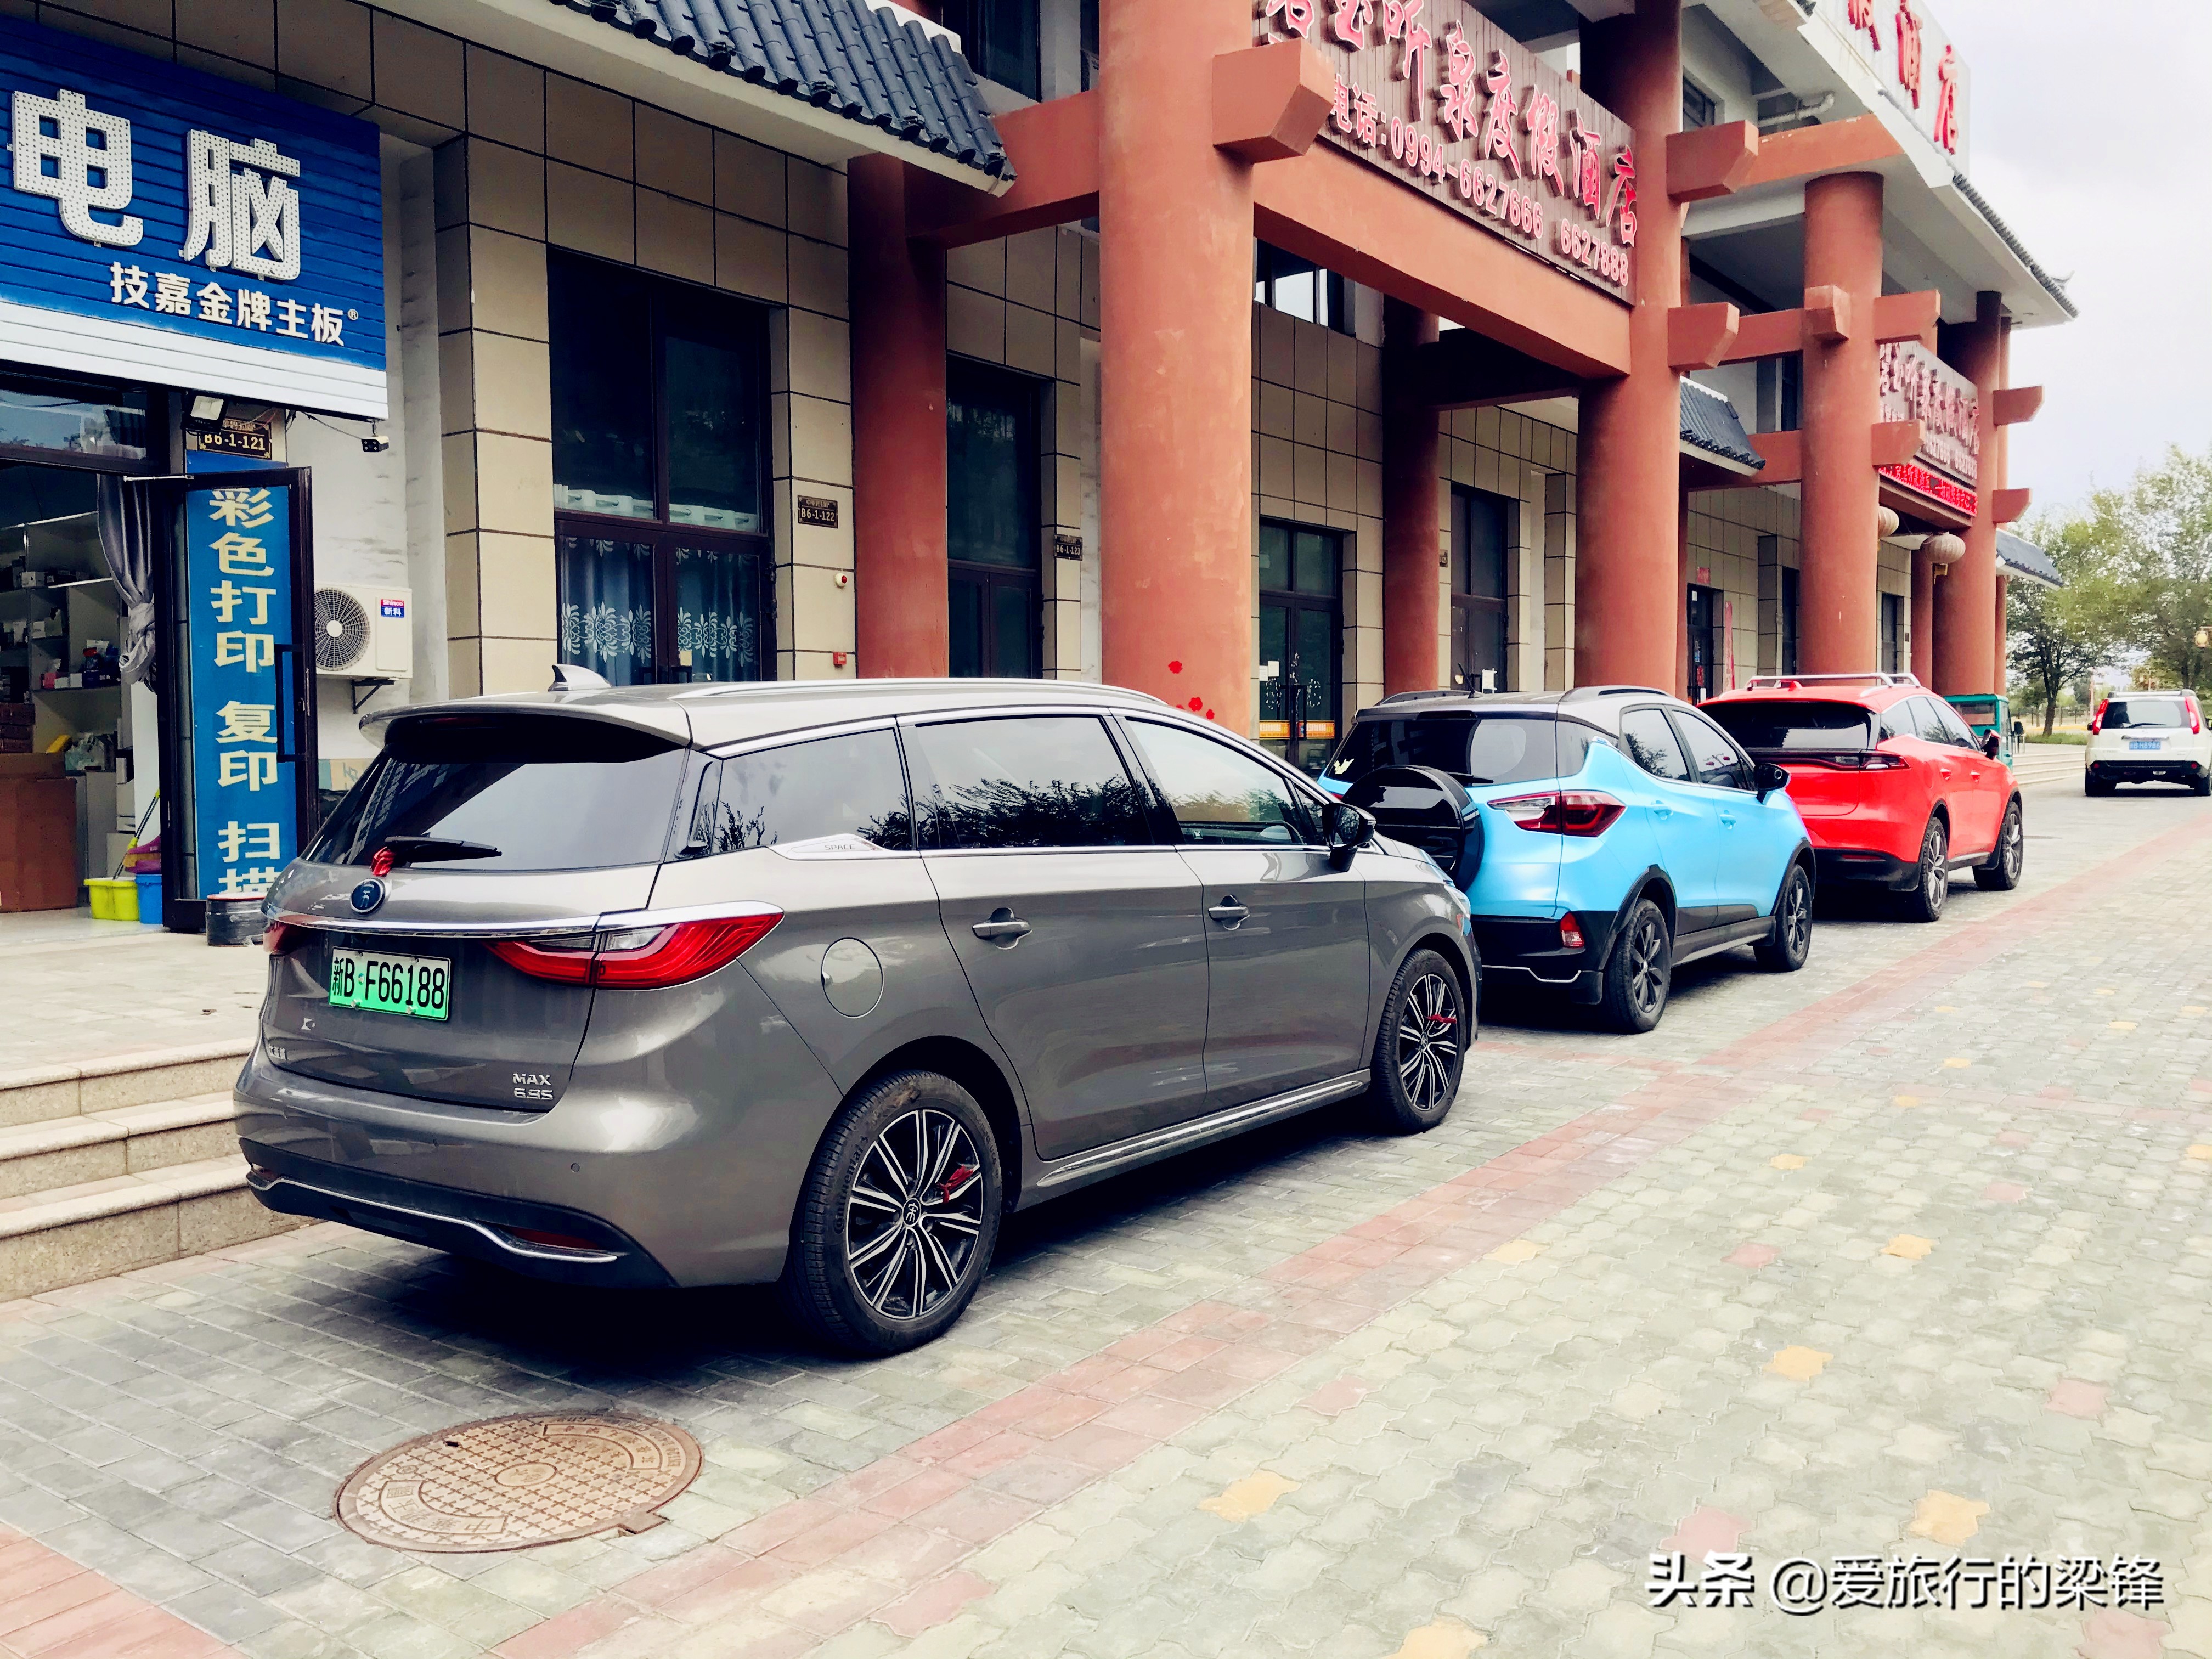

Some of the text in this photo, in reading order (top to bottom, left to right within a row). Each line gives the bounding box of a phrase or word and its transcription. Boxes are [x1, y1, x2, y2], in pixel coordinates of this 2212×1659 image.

[11, 88, 301, 281] 电脑
[1560, 218, 1629, 287] 6627888
[204, 433, 266, 451] B6-1-121
[801, 507, 834, 522] B6-1-122
[1056, 544, 1081, 555] B6-1-123
[208, 487, 276, 673] 彩色打印
[384, 607, 402, 617] 新科
[215, 699, 278, 792] 复印
[512, 1073, 551, 1086] MAX
